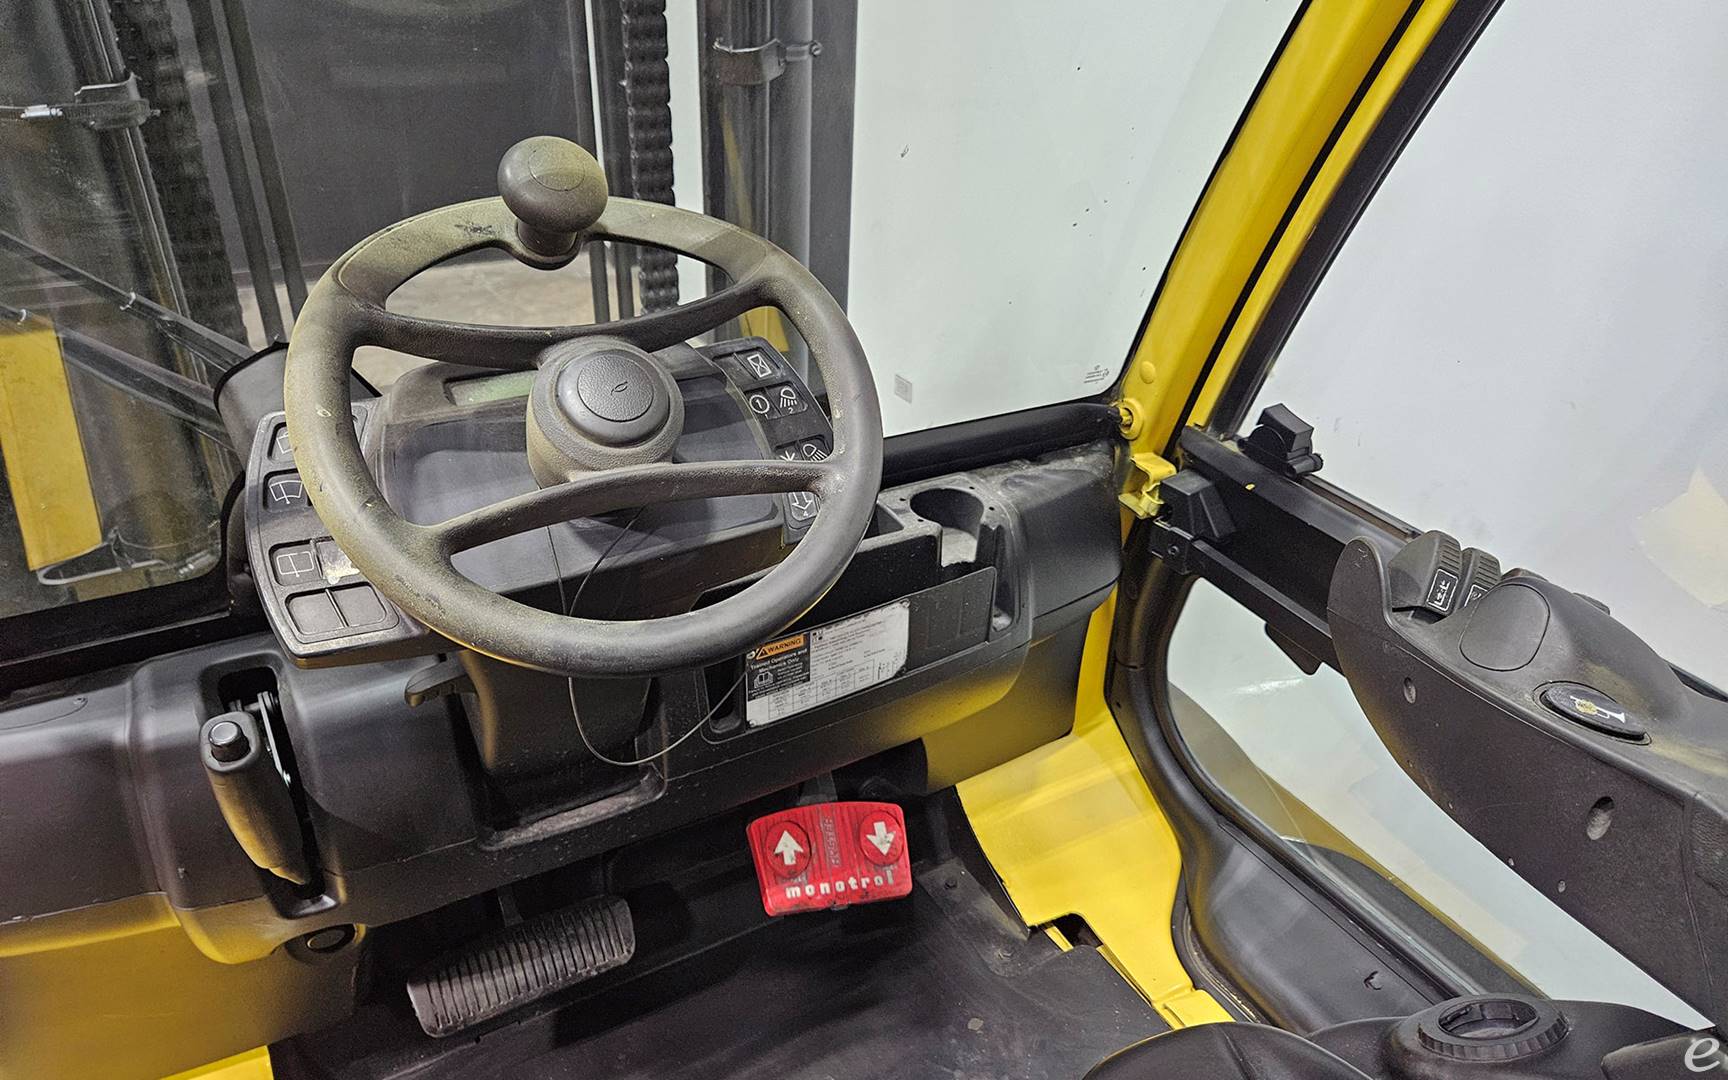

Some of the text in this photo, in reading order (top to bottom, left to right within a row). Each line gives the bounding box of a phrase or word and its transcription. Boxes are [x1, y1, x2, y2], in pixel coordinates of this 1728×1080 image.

[787, 406, 795, 415] 2
[767, 638, 801, 653] WARNING
[785, 869, 894, 899] monotrol
